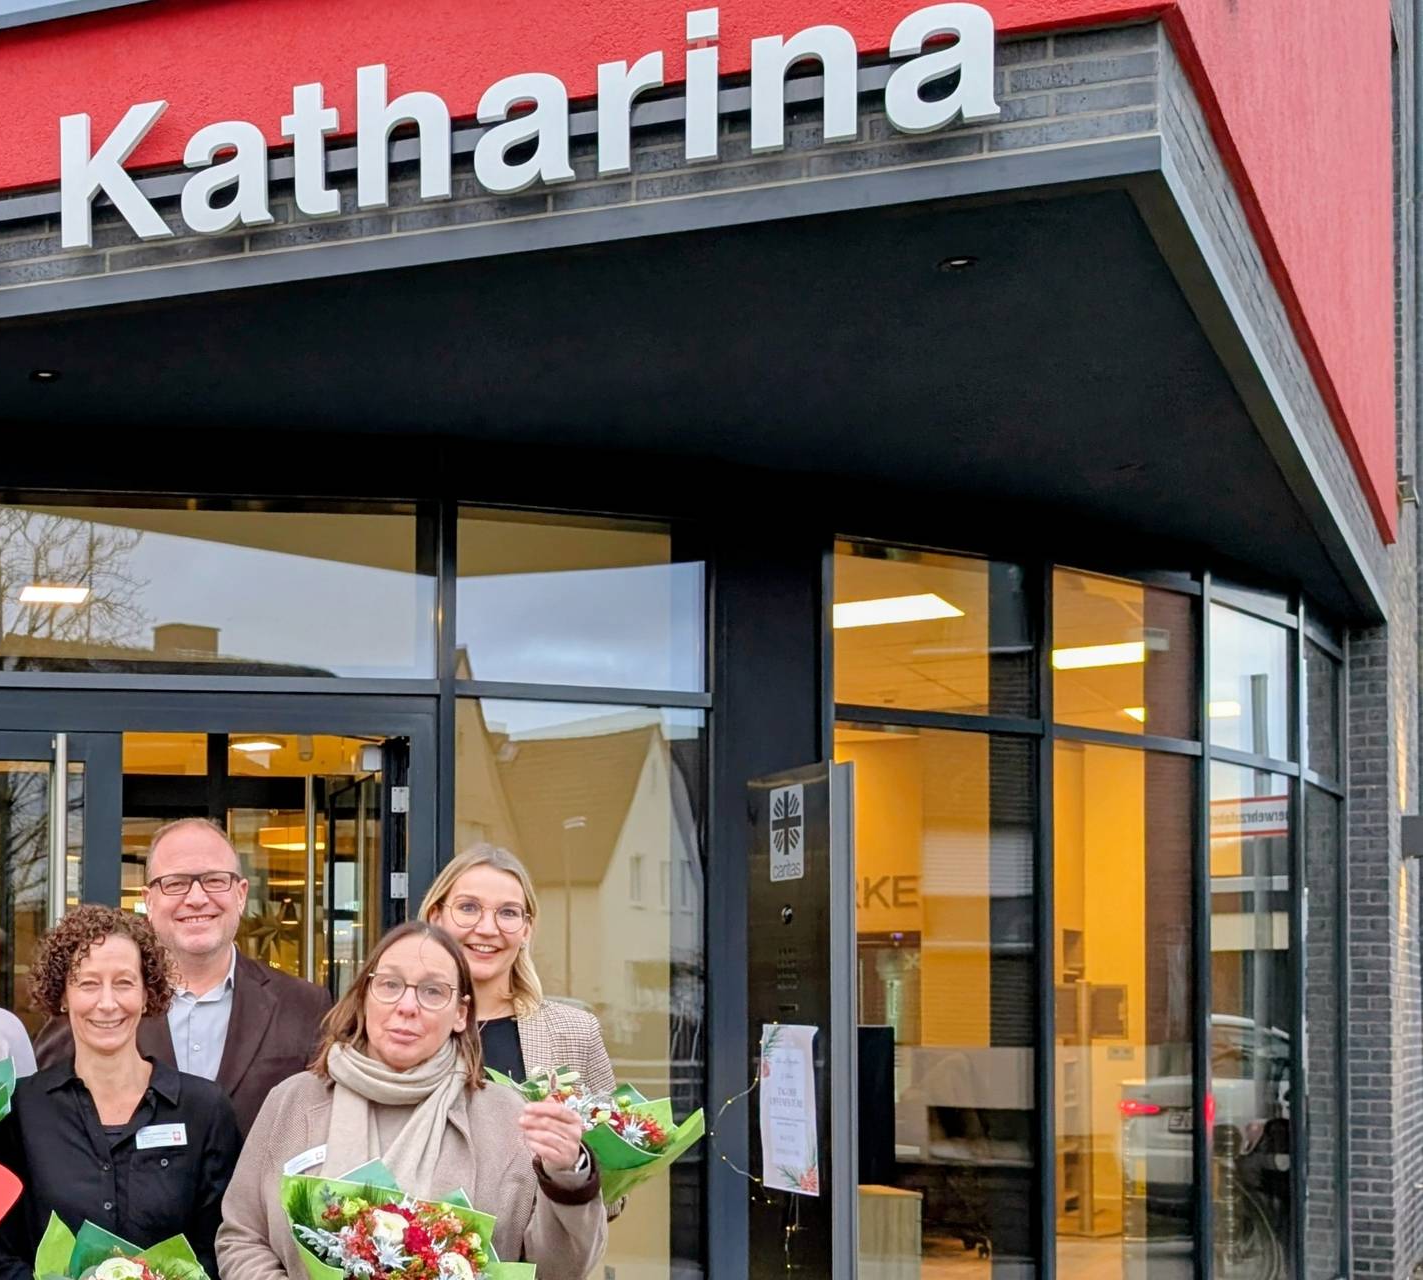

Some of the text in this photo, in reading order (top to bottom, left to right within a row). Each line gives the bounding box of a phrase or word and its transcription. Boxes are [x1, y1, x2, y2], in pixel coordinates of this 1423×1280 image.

[59, 2, 1001, 249] Katharina
[772, 859, 802, 879] caritas
[856, 875, 919, 909] KE
